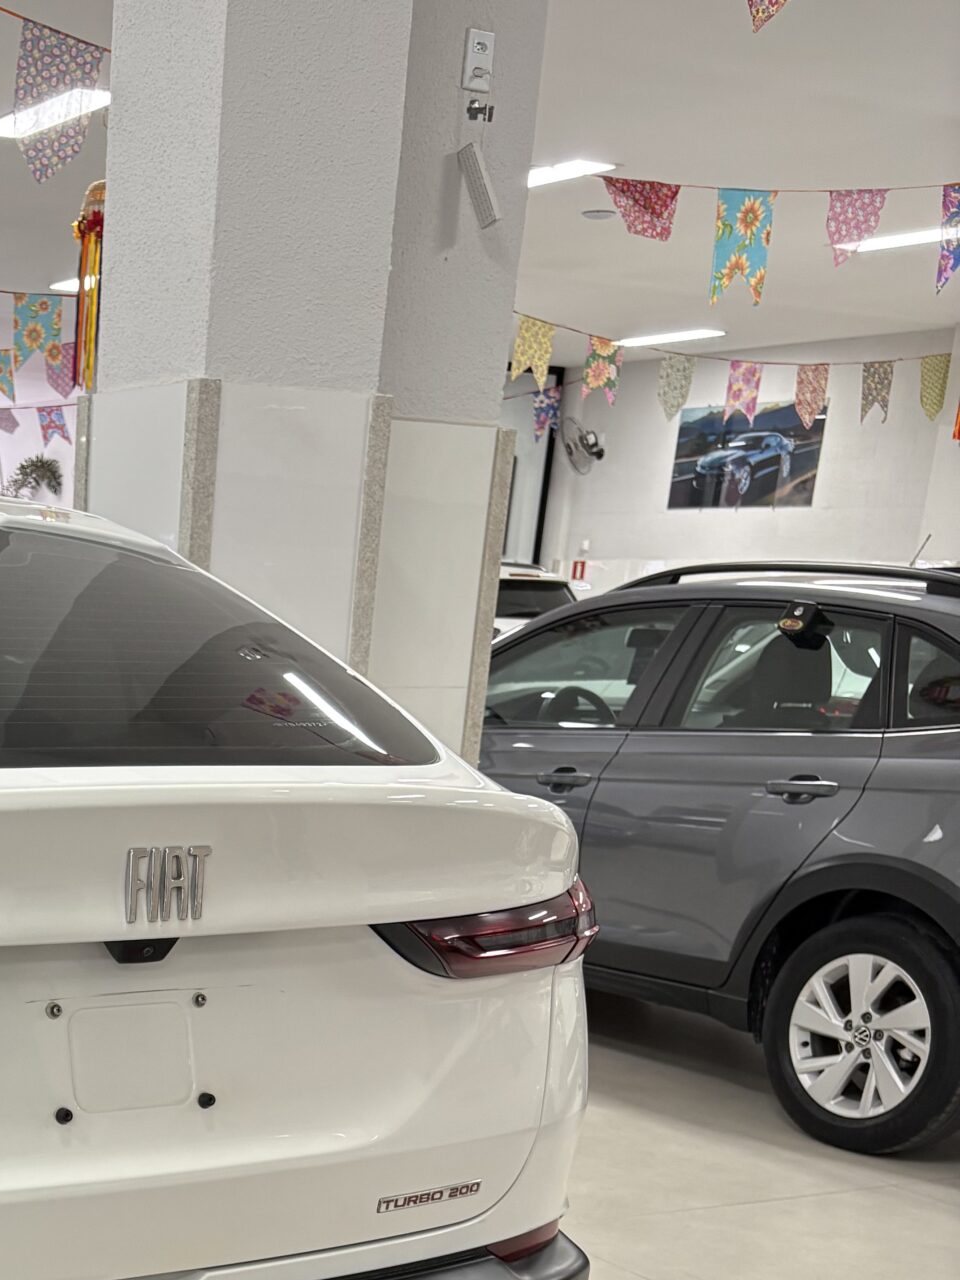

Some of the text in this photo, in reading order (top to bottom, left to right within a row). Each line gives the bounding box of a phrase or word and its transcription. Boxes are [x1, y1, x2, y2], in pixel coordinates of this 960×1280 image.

[125, 845, 212, 924] FIAT
[382, 1181, 481, 1211] TURBO 200
